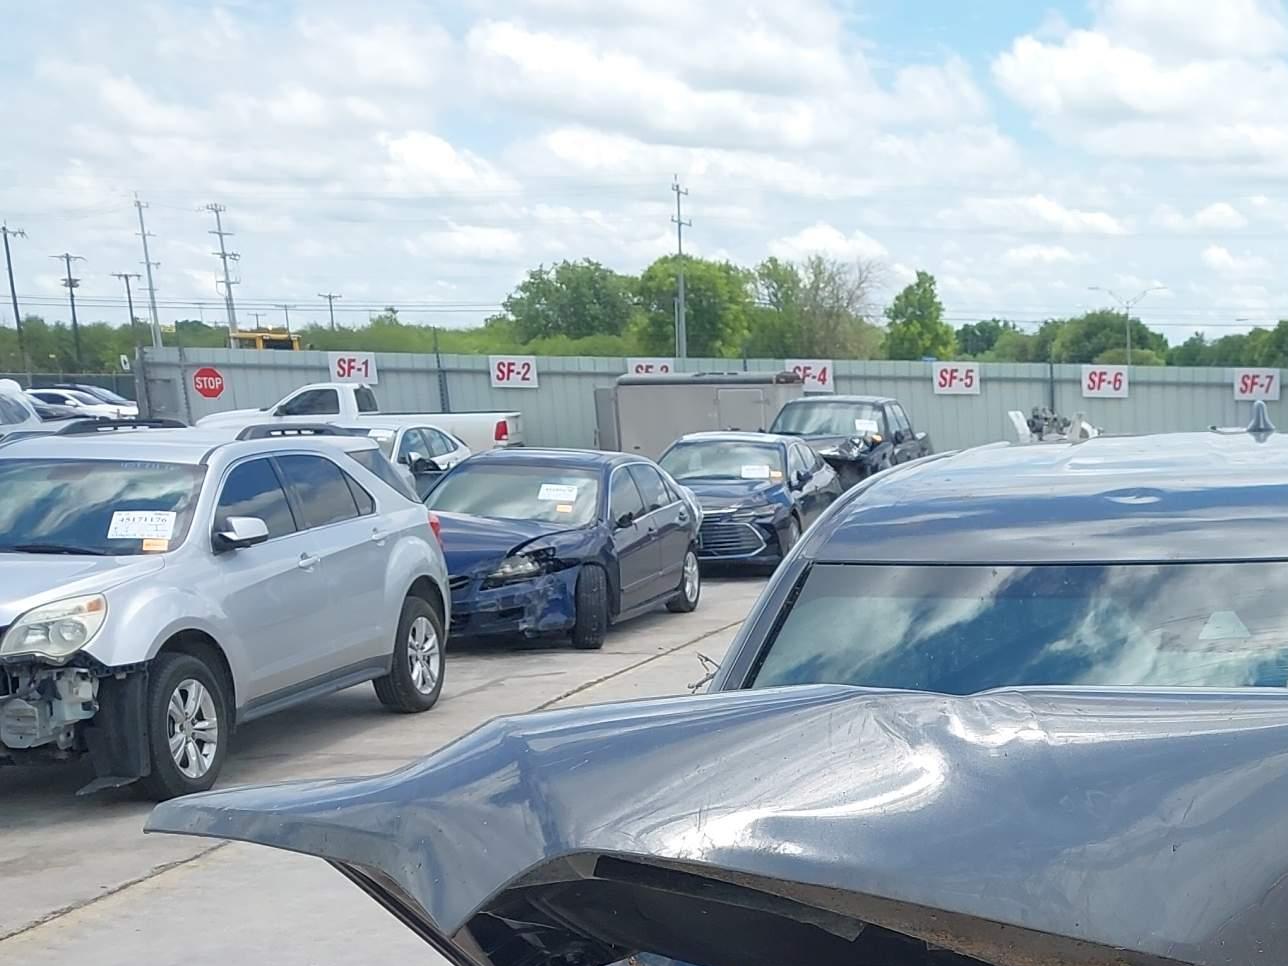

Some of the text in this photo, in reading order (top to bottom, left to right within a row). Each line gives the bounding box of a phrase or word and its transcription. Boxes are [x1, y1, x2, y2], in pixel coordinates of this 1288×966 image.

[336, 357, 369, 378] SF-1
[496, 361, 531, 381] SF-2
[793, 366, 827, 385] SF-4
[195, 377, 222, 389] STOP
[938, 368, 974, 388] SF-5
[1087, 371, 1123, 391] SF-6
[1239, 374, 1274, 394] SF-7
